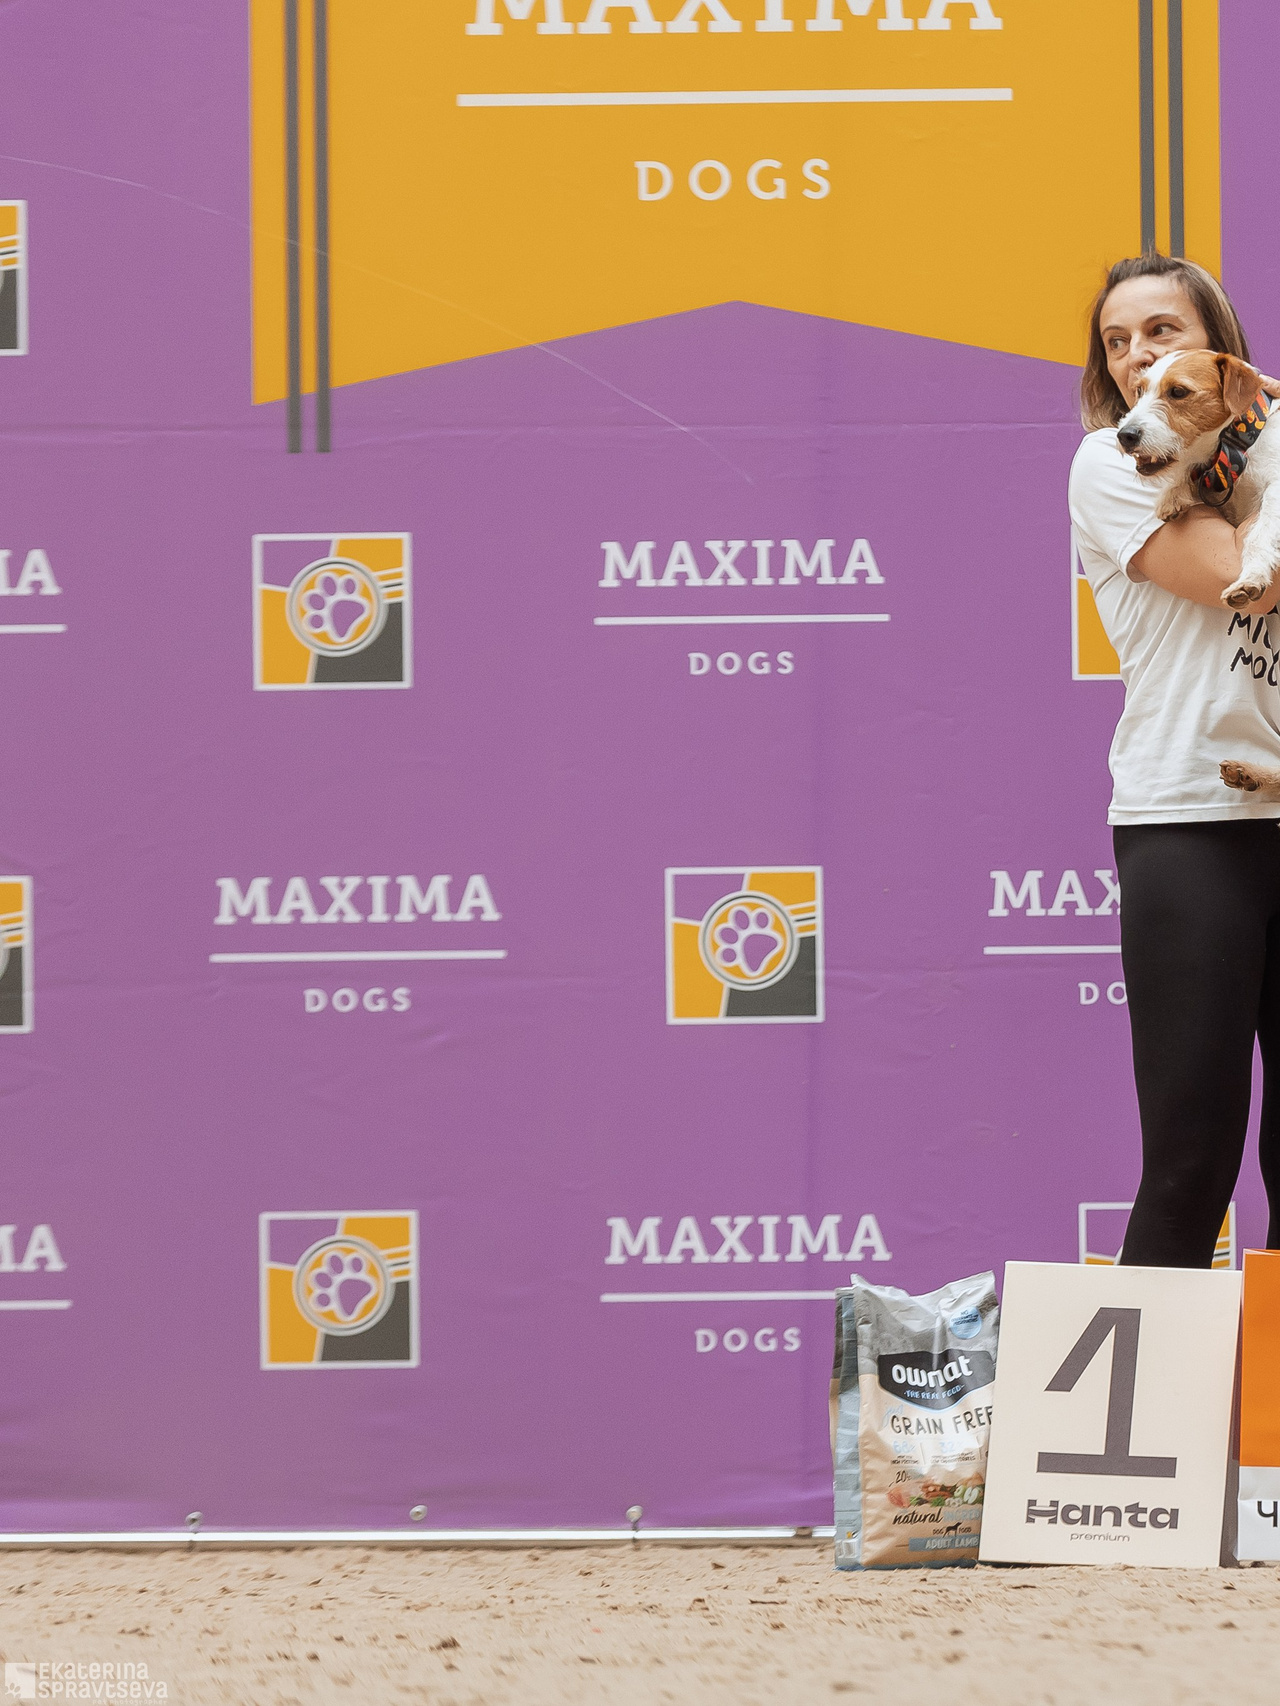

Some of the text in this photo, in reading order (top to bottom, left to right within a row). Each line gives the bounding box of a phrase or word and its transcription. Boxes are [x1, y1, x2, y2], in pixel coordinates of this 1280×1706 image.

[635, 158, 830, 201] DOGS
[598, 538, 885, 588] MAXIMA
[688, 652, 794, 676] DOGS
[213, 874, 502, 926] MAXIMA
[988, 869, 1121, 917] MAX
[303, 987, 410, 1013] DOGS
[1078, 981, 1127, 1005] DO
[604, 1214, 892, 1265] MAXIMA
[694, 1327, 801, 1353] DOGS
[892, 1355, 973, 1388] ownat
[1036, 1307, 1178, 1479] 1
[890, 1414, 944, 1436] GRAIN
[892, 1508, 944, 1525] natural
[1026, 1499, 1179, 1529] Hanta
[1070, 1532, 1131, 1542] premium
